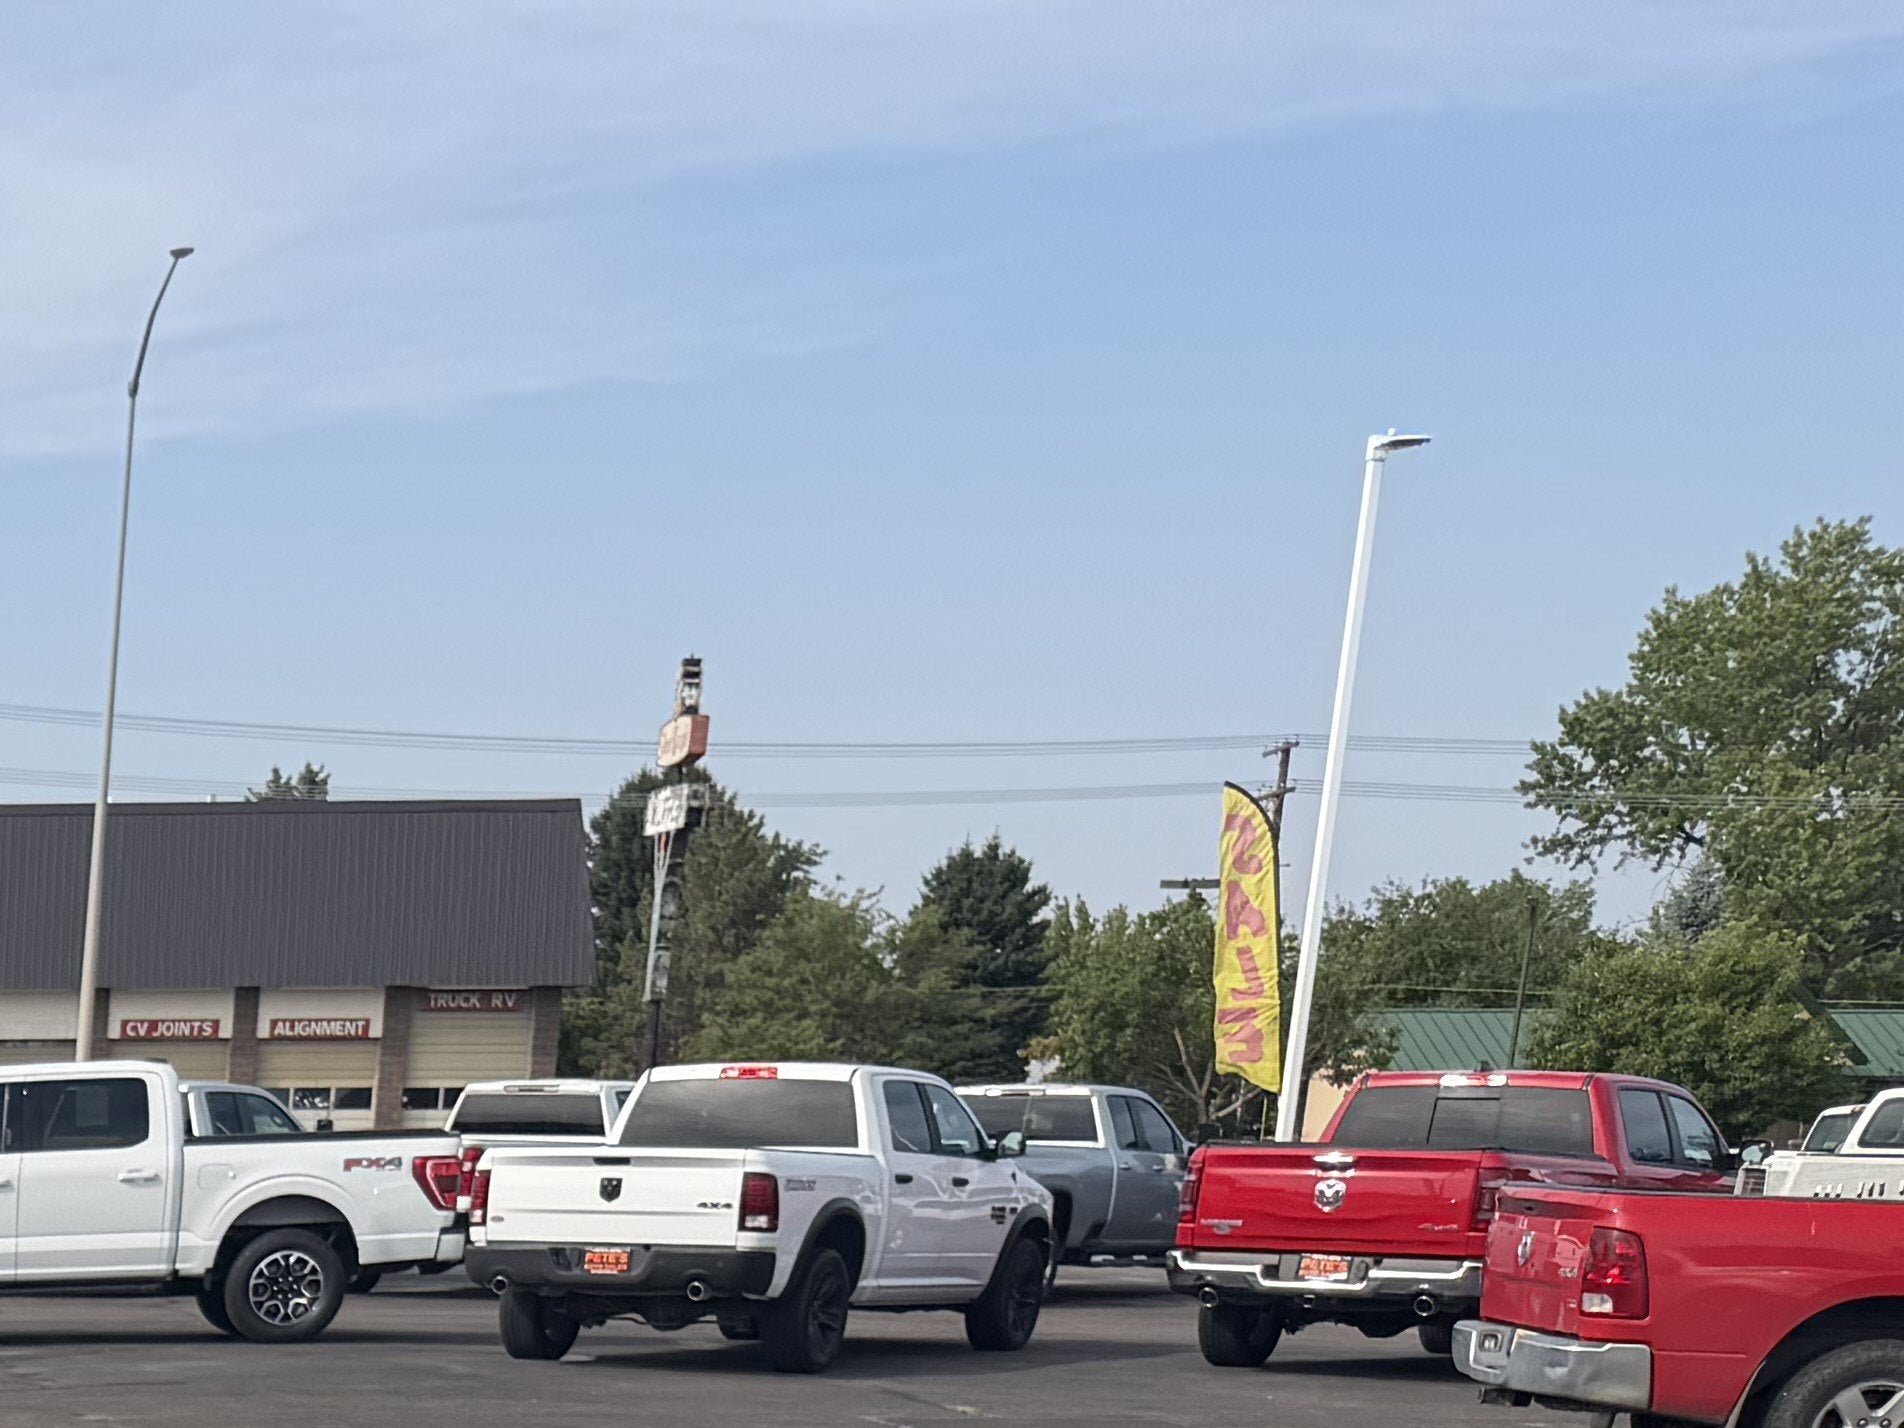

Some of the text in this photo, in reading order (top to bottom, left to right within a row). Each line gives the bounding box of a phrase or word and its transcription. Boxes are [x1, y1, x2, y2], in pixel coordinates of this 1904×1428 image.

[428, 993, 517, 1009] TRUCK RV
[126, 1021, 213, 1037] CV JOINTS
[273, 1021, 366, 1036] ALIGNMENT
